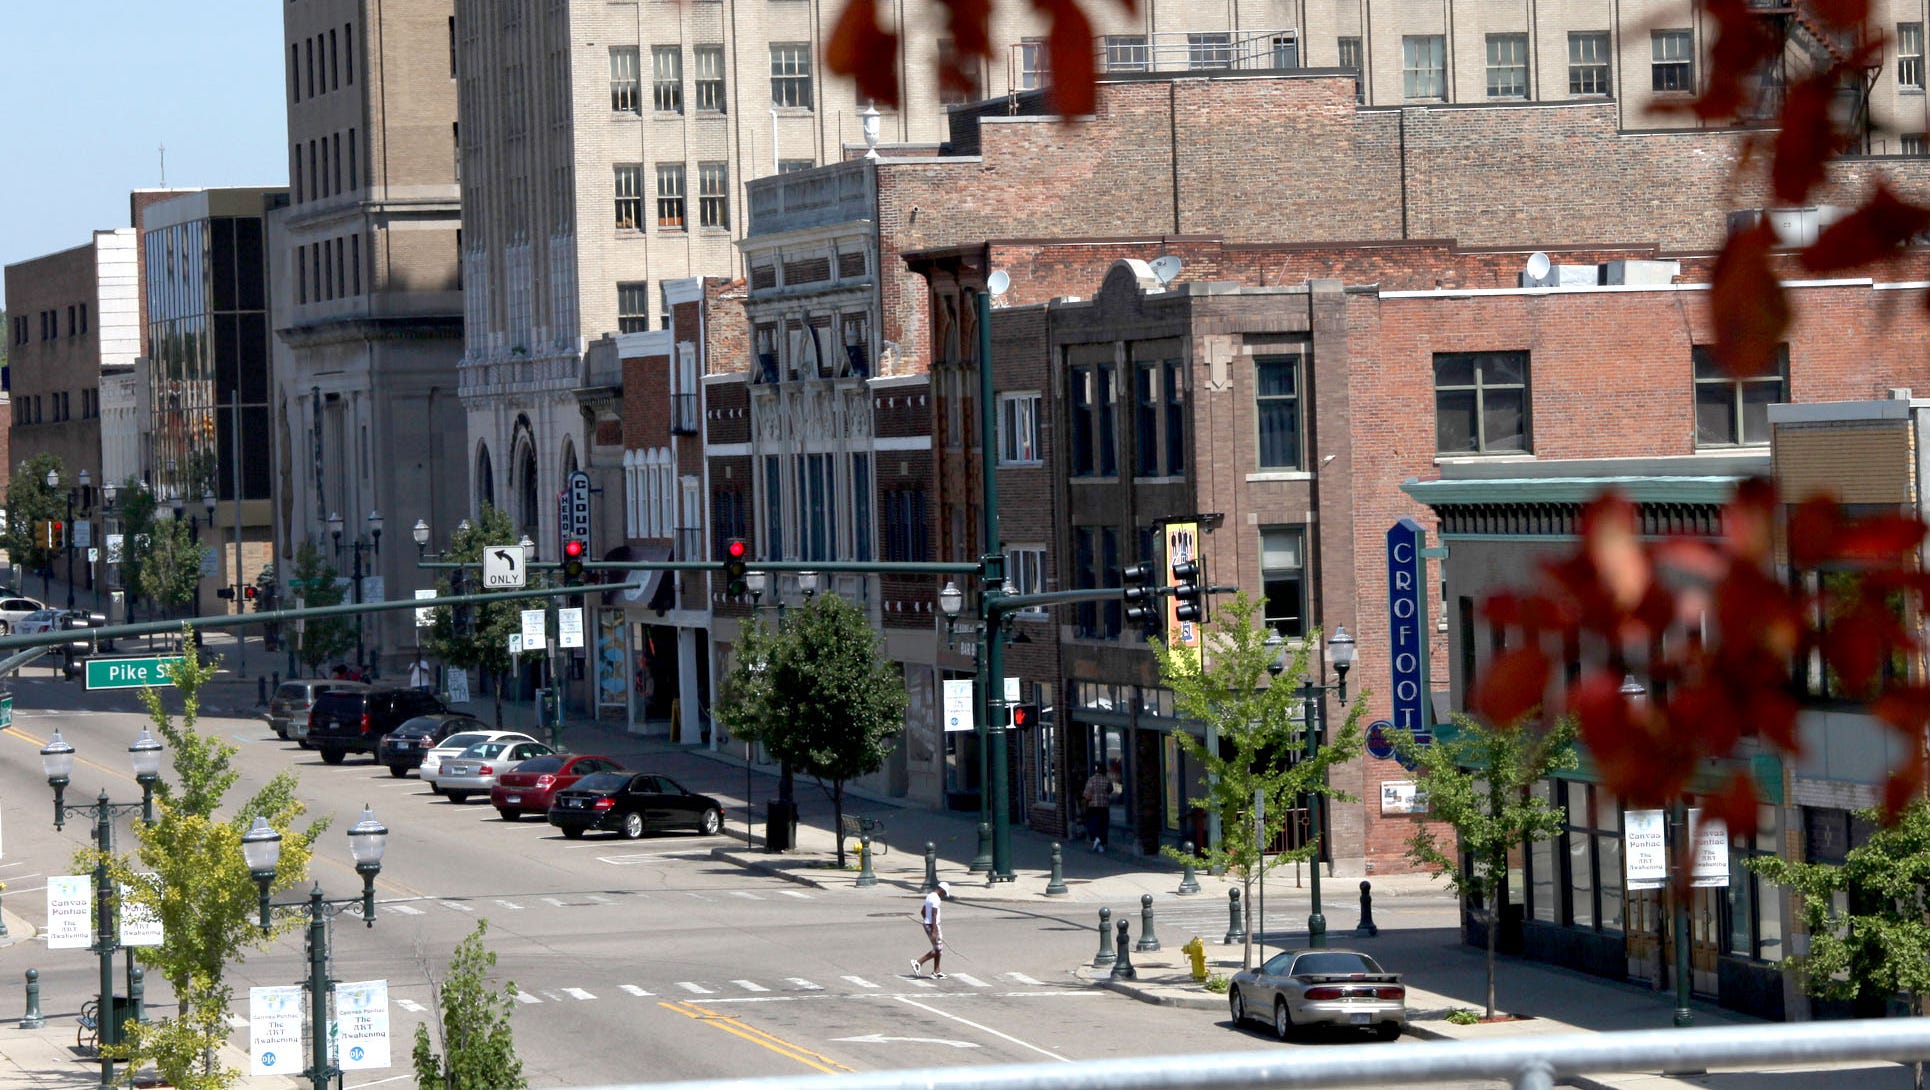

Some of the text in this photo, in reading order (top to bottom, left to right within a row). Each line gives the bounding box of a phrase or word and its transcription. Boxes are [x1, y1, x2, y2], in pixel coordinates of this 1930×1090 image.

[575, 480, 587, 536] CLOUD
[490, 575, 519, 584] ONLY
[1393, 543, 1417, 729] CROFOOT
[109, 664, 148, 681] Pike
[1629, 832, 1662, 840] Canvas
[51, 899, 87, 907] Canvas
[52, 908, 87, 916] Pontiac
[353, 1023, 373, 1031] ART
[341, 1031, 386, 1039] Awakening
[254, 1037, 298, 1045] Awakening
